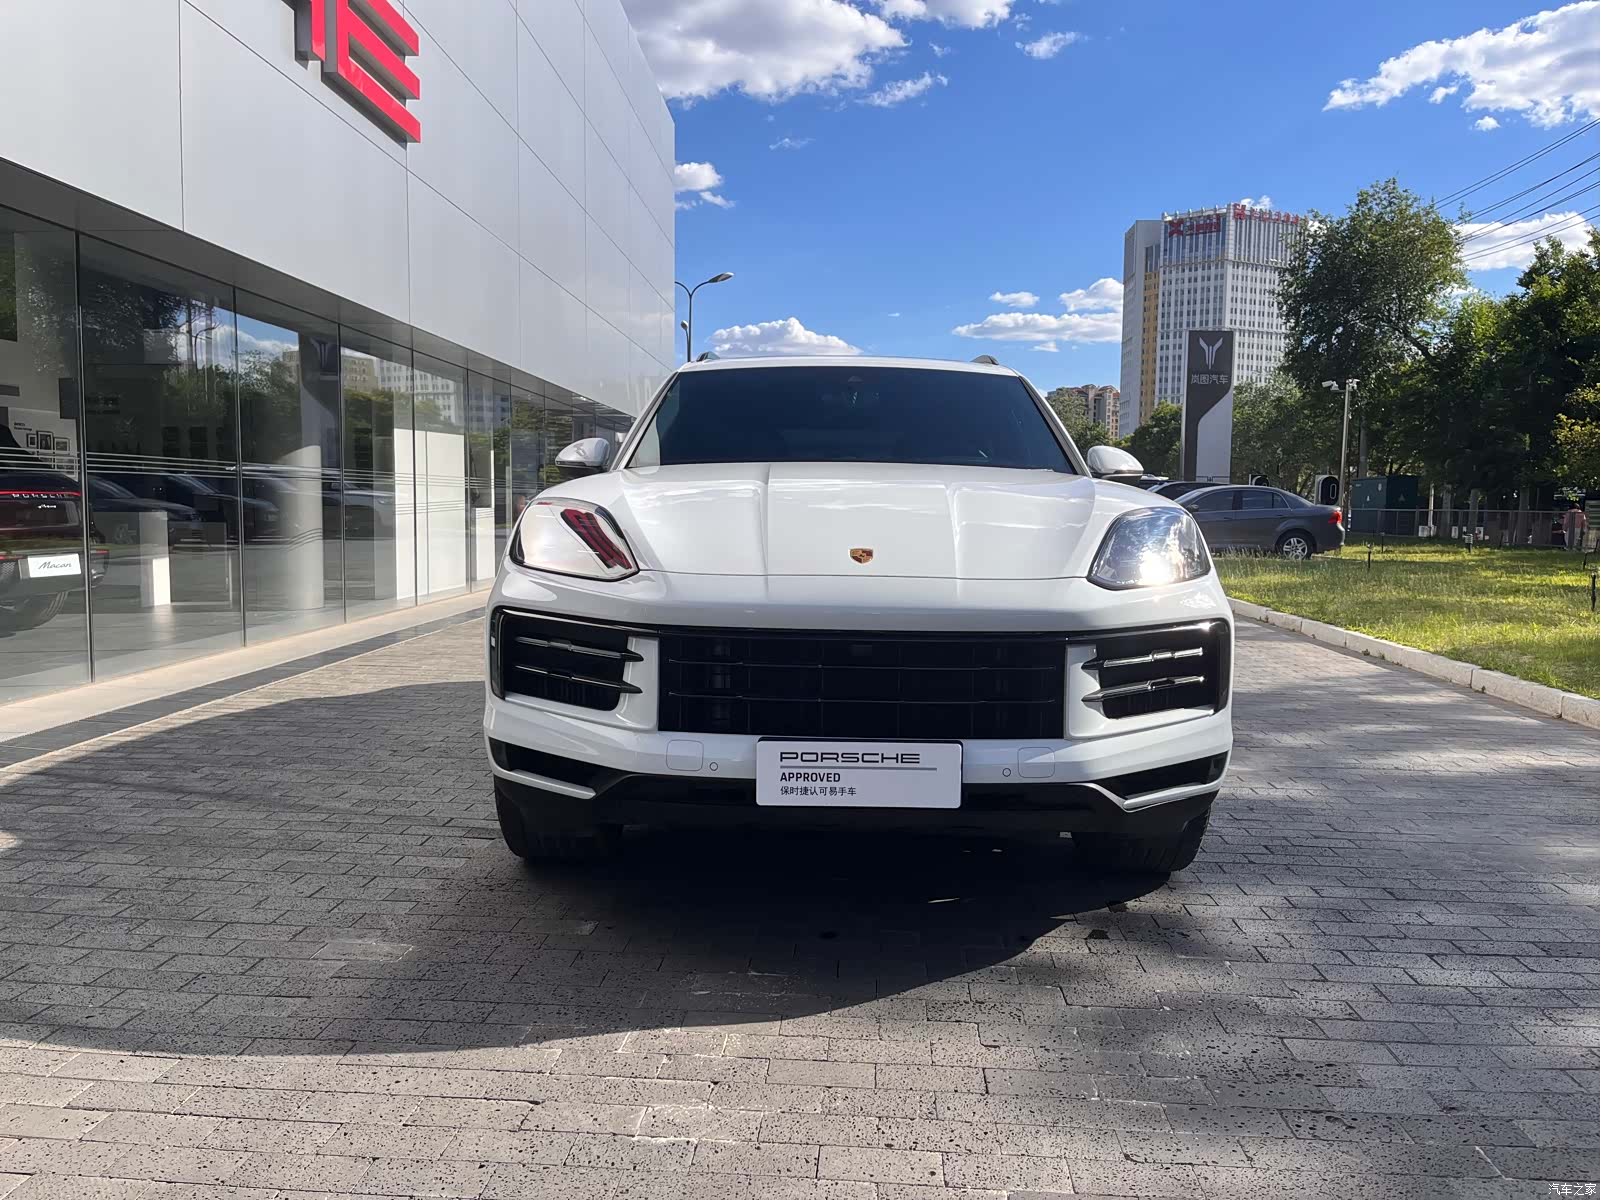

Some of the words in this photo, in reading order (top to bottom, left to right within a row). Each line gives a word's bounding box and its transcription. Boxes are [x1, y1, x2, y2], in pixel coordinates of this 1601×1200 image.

[1191, 373, 1229, 385] 岚图汽车
[38, 561, 72, 570] Macan
[779, 752, 921, 764] PORSCHE
[780, 772, 841, 782] APPROVED
[780, 786, 857, 796] 保时捷认可易手车
